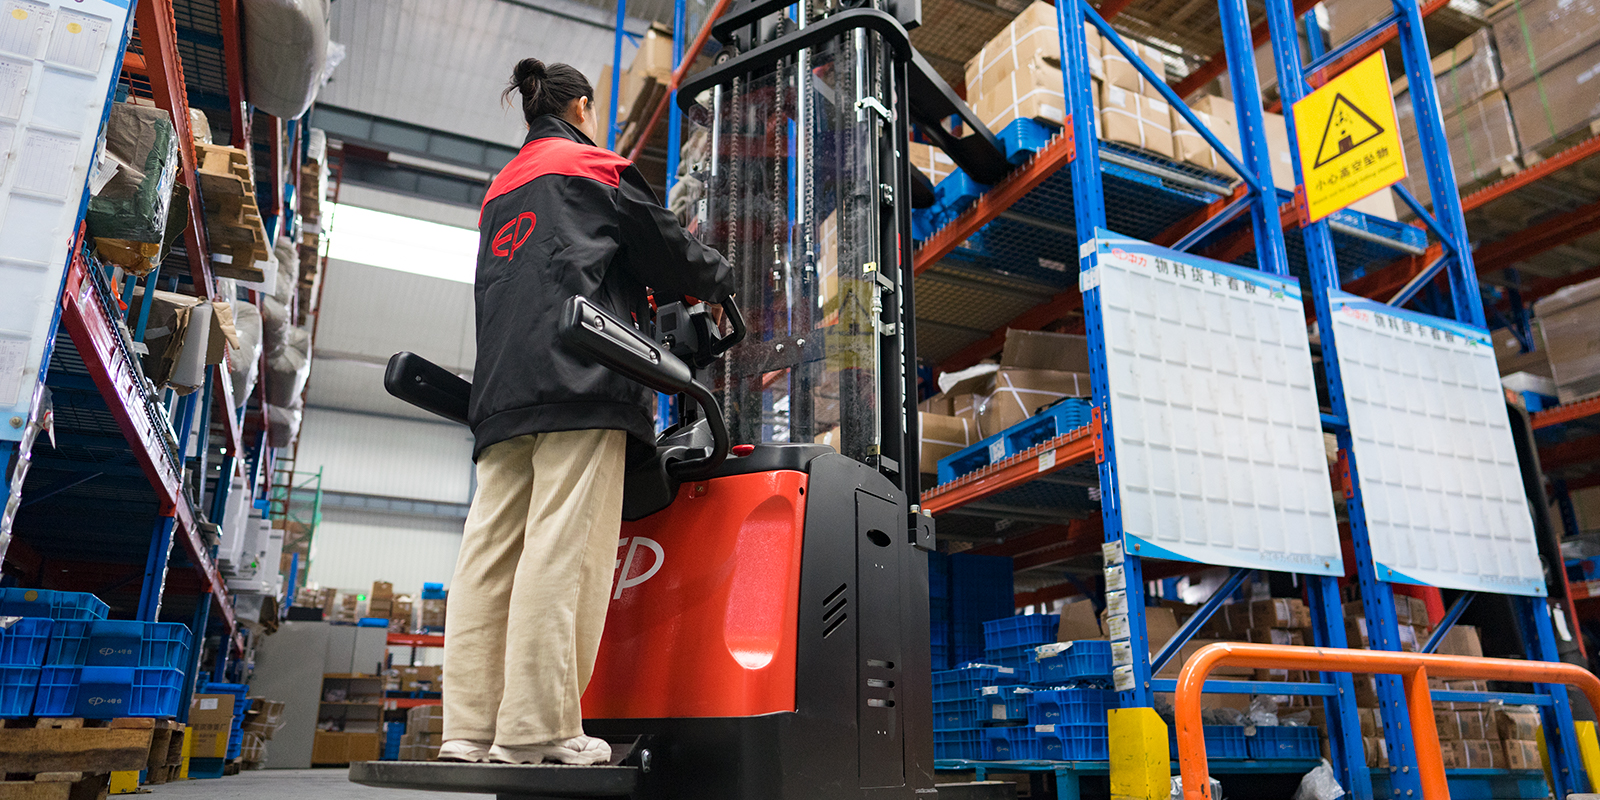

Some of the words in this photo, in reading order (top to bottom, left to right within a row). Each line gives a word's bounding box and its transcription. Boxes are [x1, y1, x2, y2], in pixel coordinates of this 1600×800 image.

[1315, 147, 1389, 191] 小心高空坠物
[491, 211, 537, 262] EP
[1155, 257, 1257, 295] 物料货卡看板
